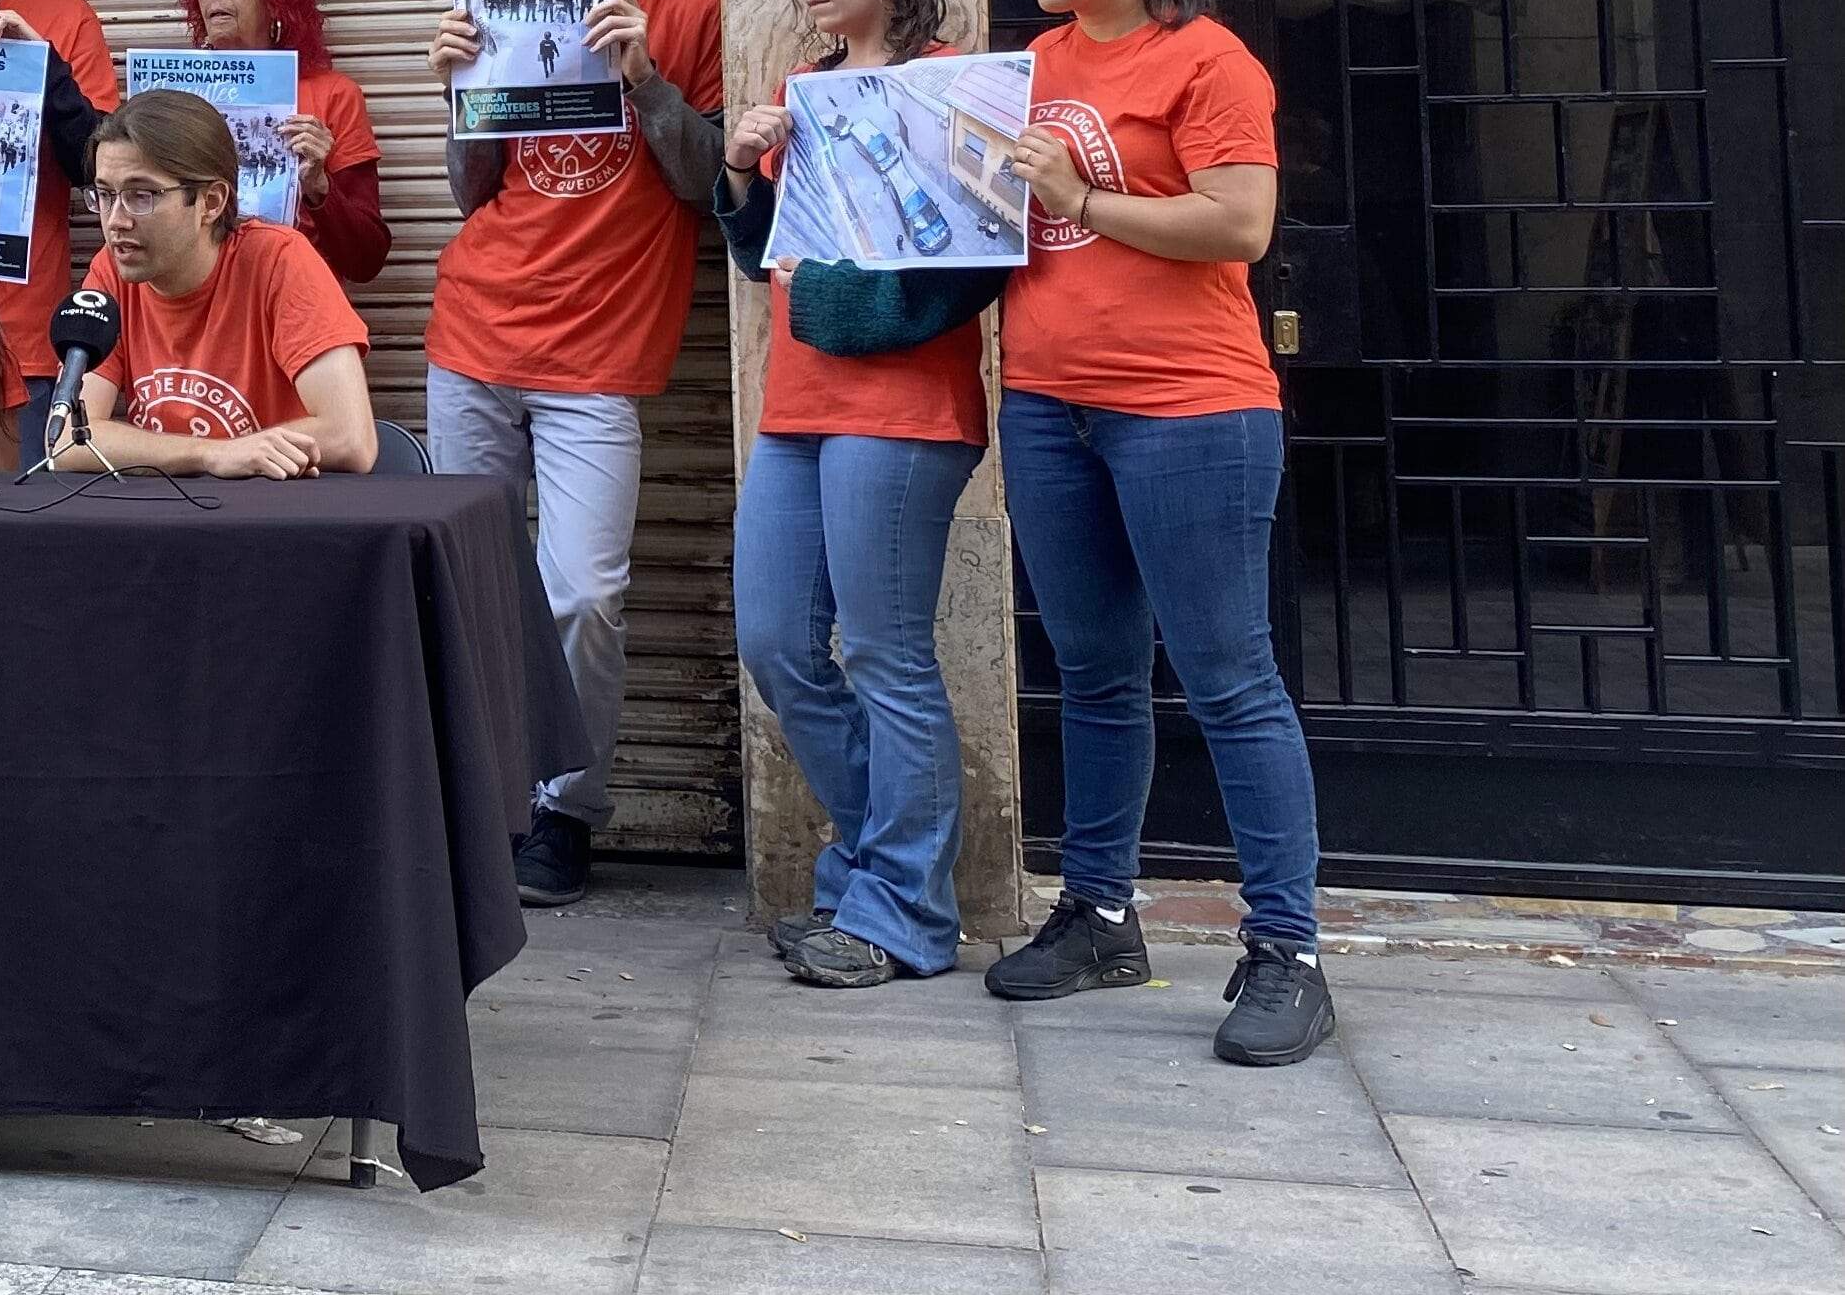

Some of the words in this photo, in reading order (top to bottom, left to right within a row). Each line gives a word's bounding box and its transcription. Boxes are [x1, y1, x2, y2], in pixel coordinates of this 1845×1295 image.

[133, 58, 148, 69] NI
[151, 59, 180, 70] LLEI
[183, 59, 256, 71] MORDASSA
[151, 72, 255, 84] DESNONAMENTS
[469, 92, 509, 103] SINDICAT
[478, 102, 540, 114] LLOGATERES
[1035, 106, 1059, 122] DE
[555, 164, 615, 192] QUEDEM
[1041, 223, 1091, 242] QUE
[155, 377, 174, 396] DE
